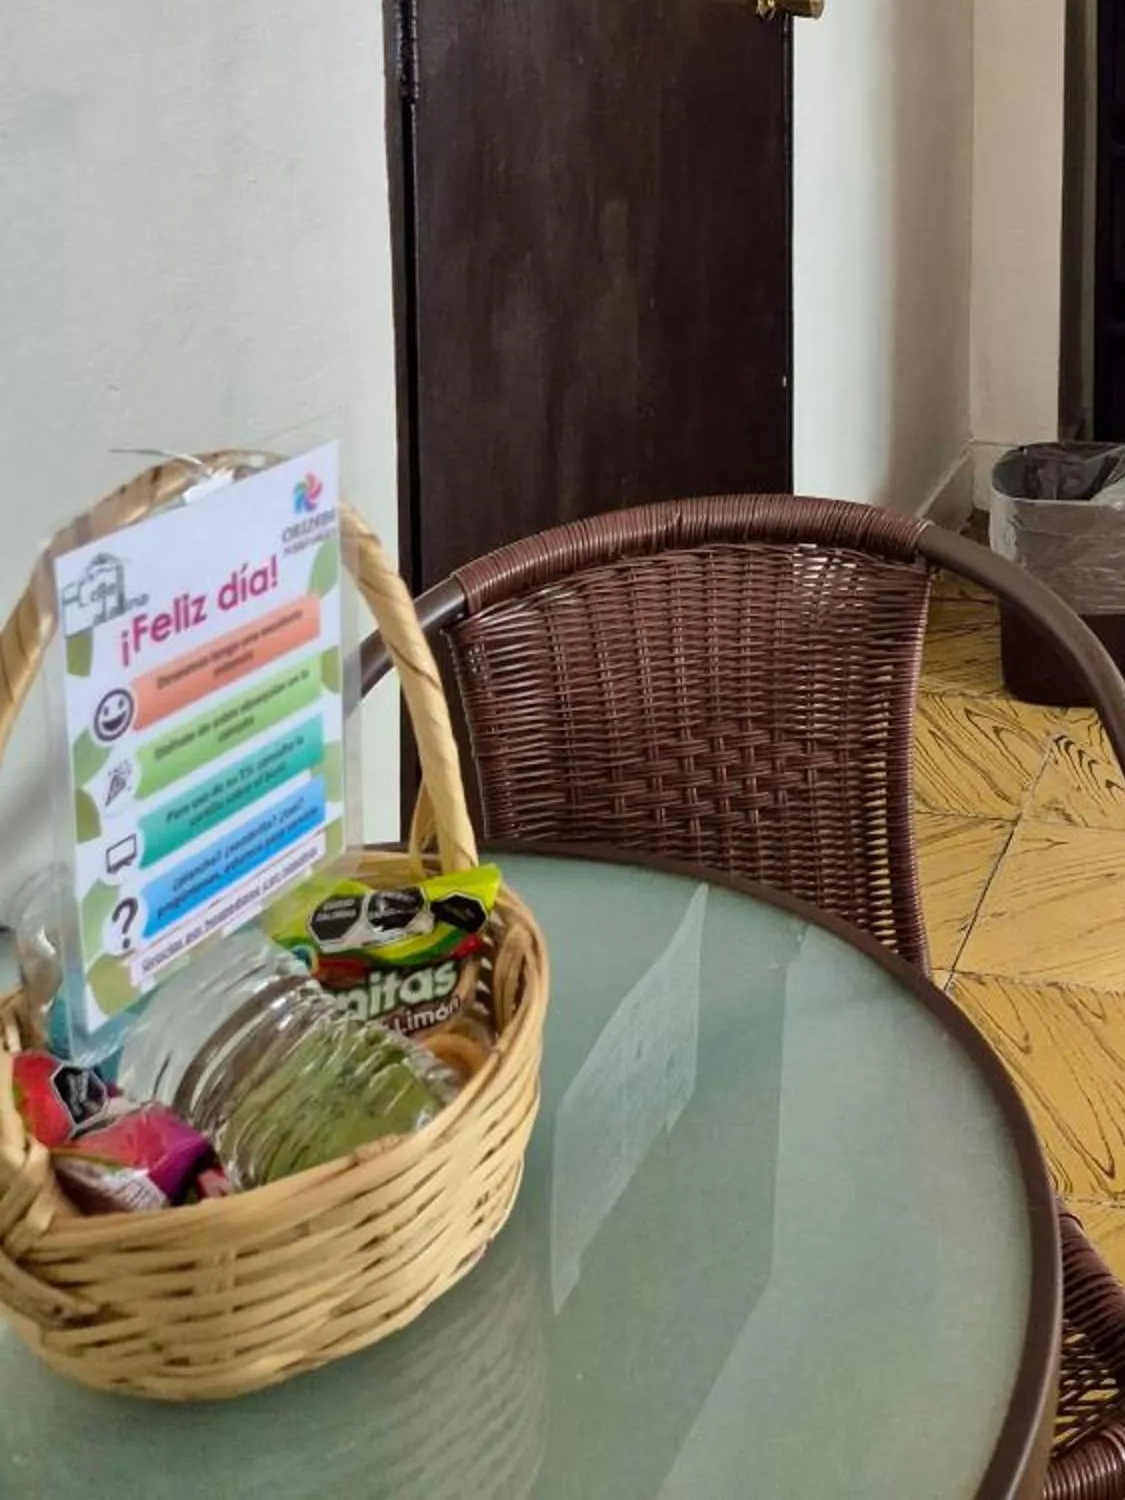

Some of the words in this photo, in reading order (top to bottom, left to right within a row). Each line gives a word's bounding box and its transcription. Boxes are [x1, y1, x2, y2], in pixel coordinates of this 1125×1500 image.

[121, 593, 208, 668] ¡Feliz
[217, 553, 279, 611] día!
[394, 995, 462, 1032] Limón
